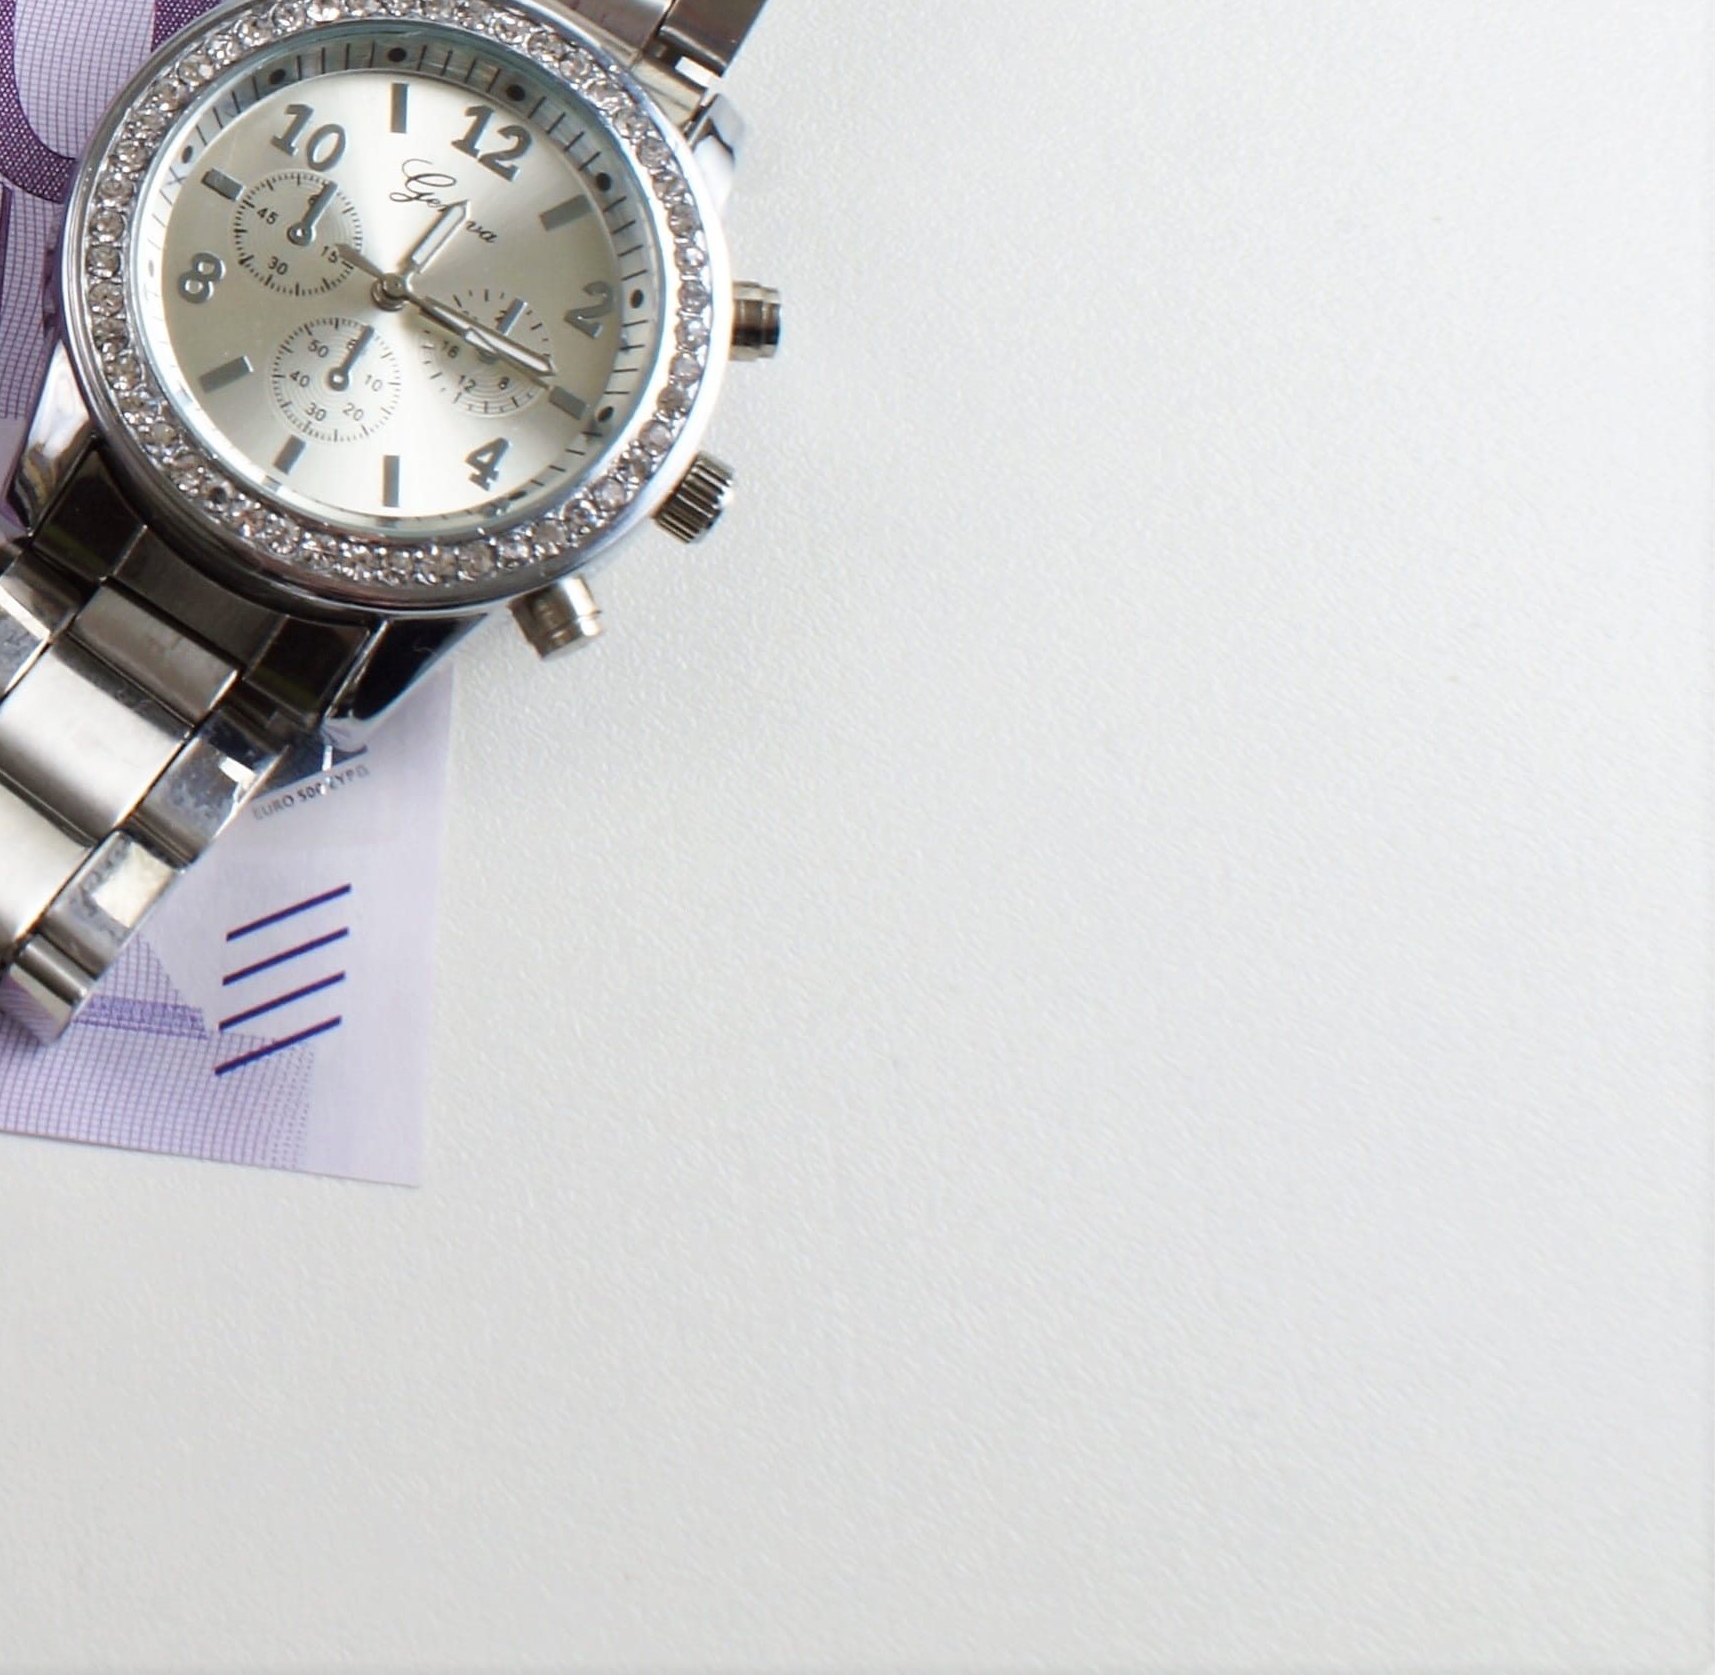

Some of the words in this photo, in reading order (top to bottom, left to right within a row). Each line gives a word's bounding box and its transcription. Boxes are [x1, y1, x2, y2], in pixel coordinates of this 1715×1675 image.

[270, 103, 347, 172] 10
[452, 104, 535, 182] 12
[389, 158, 498, 244] Geva
[256, 207, 279, 226] 45
[320, 245, 340, 265] 15
[267, 256, 288, 275] 30
[176, 251, 226, 304] 8
[563, 281, 614, 339] 2
[307, 340, 329, 359] 50
[442, 340, 460, 358] 16
[289, 370, 311, 388] 40
[365, 374, 383, 392] 10
[459, 374, 476, 391] 12
[305, 402, 327, 422] 30
[342, 402, 364, 422] 20
[465, 436, 511, 492] 4
